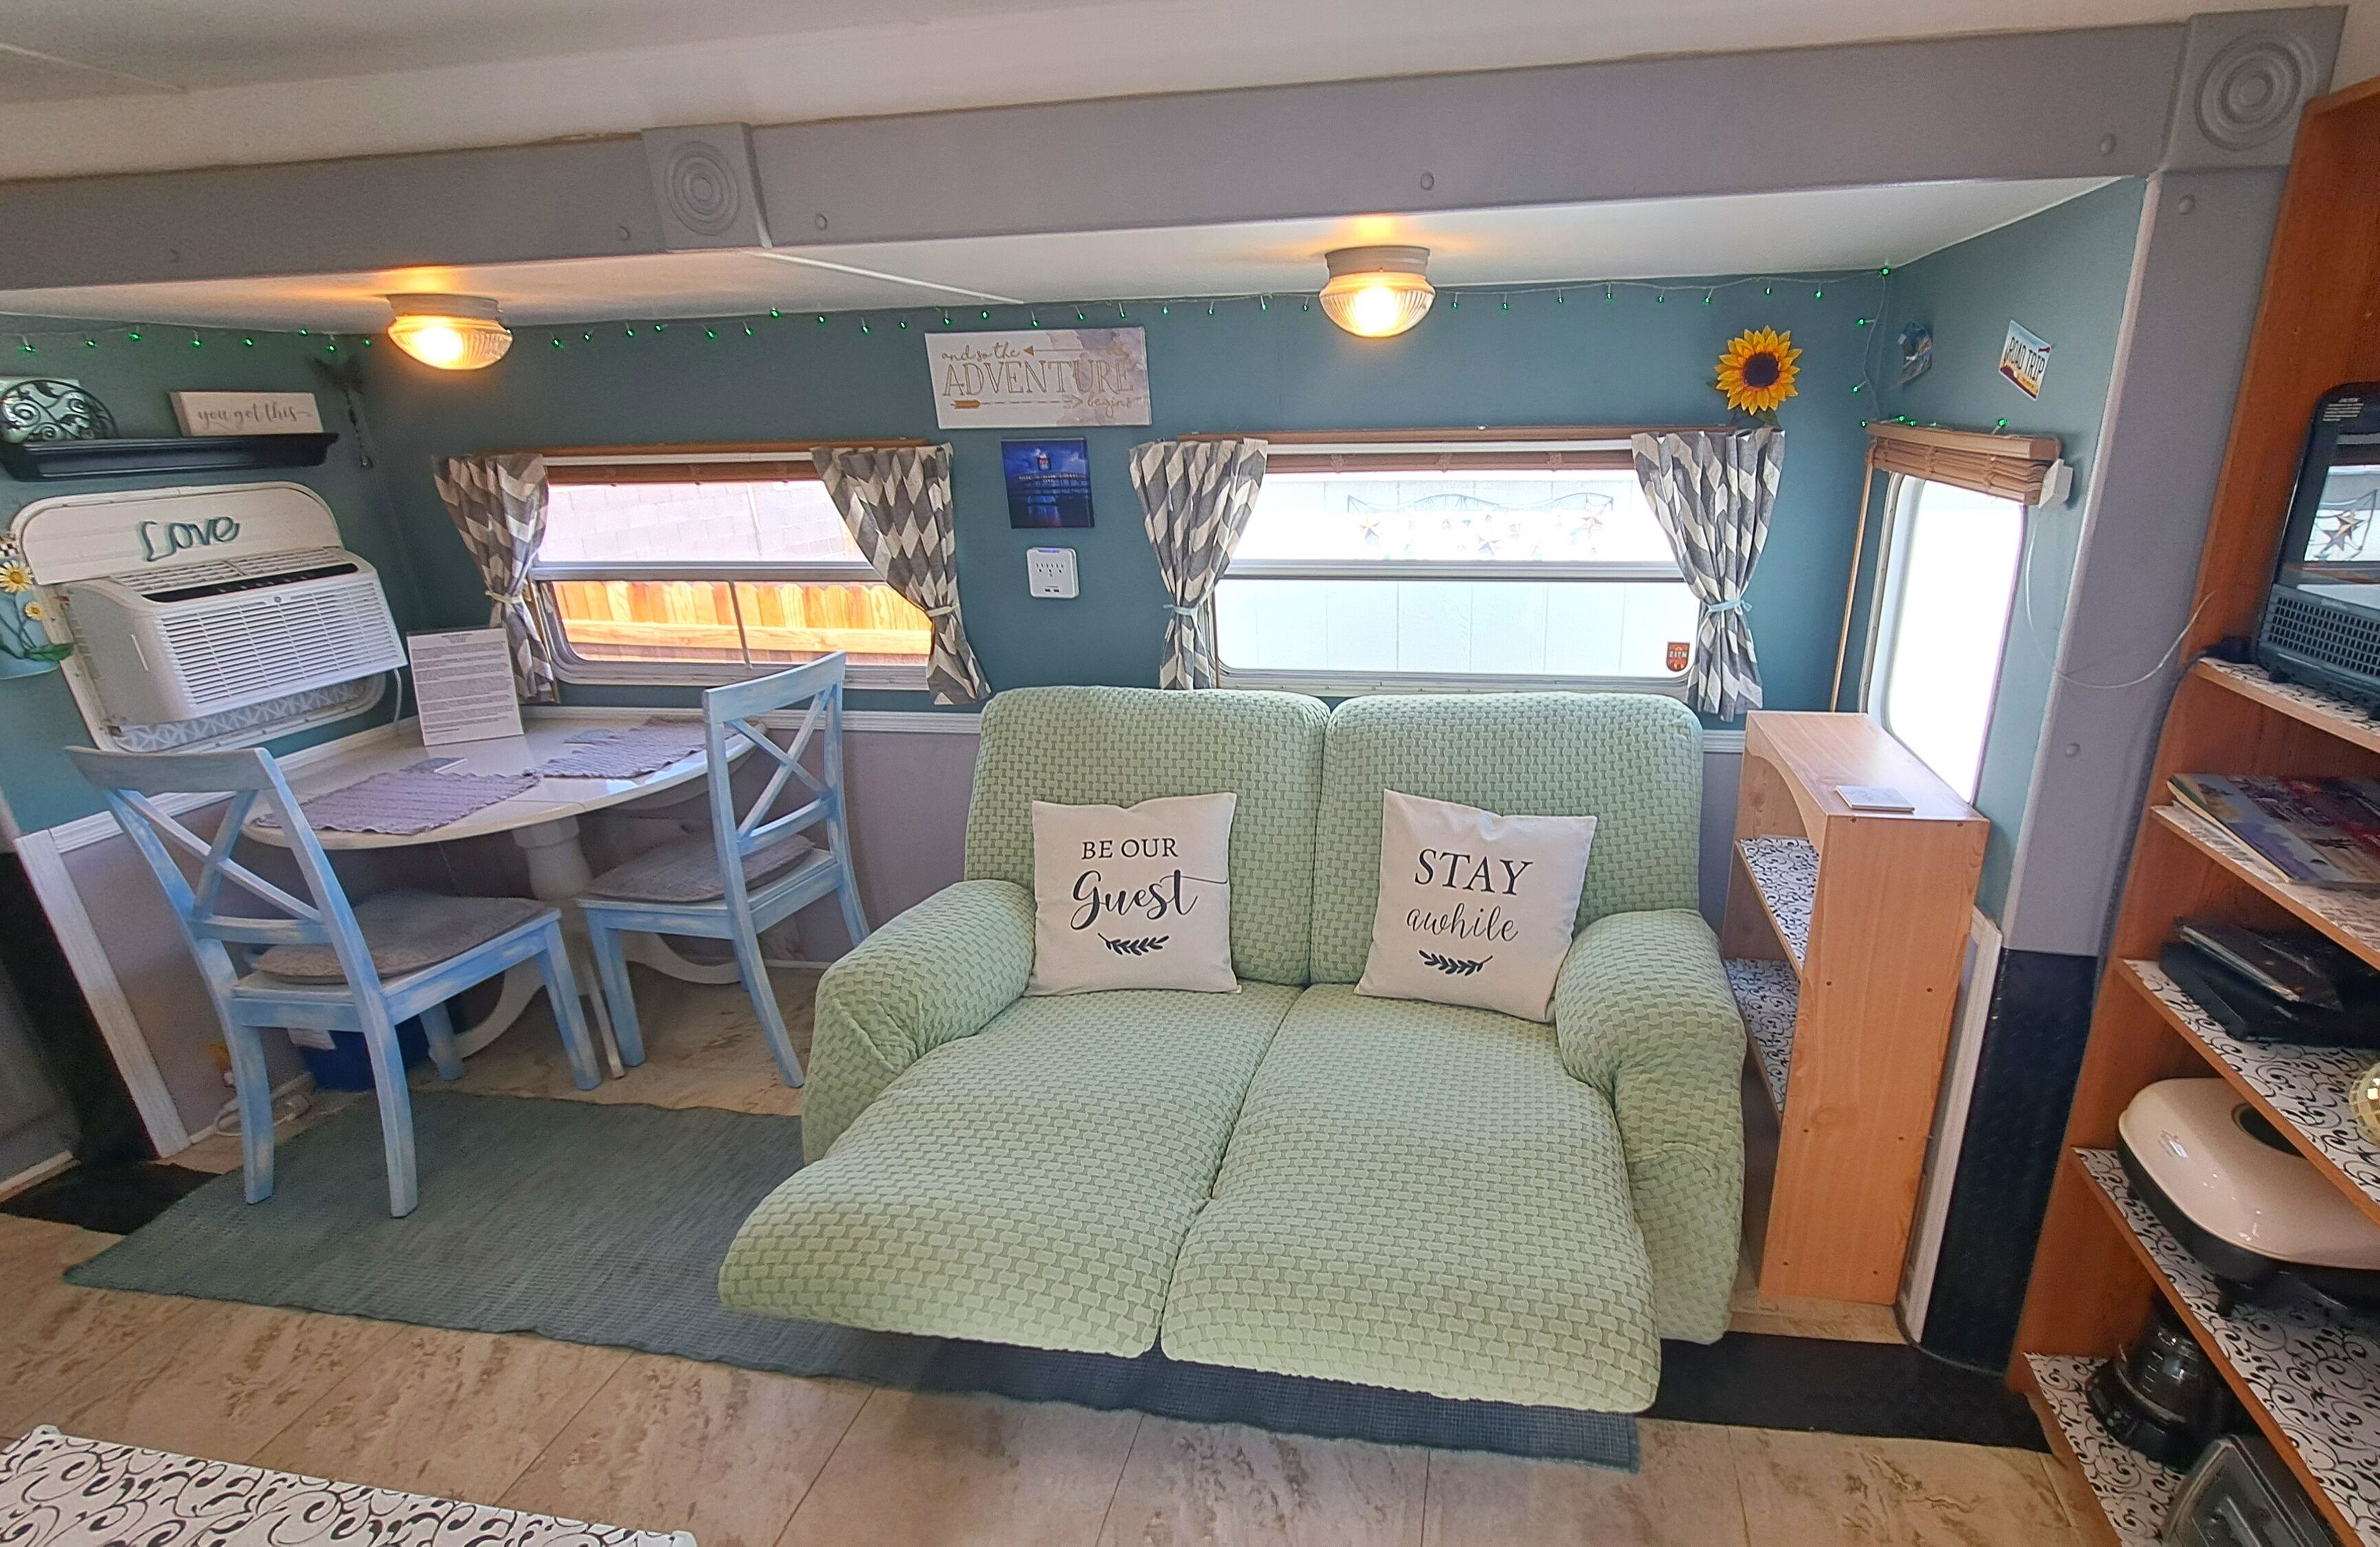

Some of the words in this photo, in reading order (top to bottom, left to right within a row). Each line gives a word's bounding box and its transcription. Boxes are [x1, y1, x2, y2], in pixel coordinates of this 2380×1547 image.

[992, 341, 1021, 360] the
[2024, 349, 2046, 382] TRIP
[941, 359, 1134, 397] ADVENTURE
[197, 409, 231, 431] you
[234, 403, 261, 430] got
[264, 401, 302, 423] this
[1087, 390, 1136, 418] begins
[140, 516, 240, 562] Love
[1081, 840, 1113, 860] BE
[1121, 837, 1179, 858] OUR
[1414, 848, 1534, 896] STAY
[1070, 868, 1228, 931] Guest
[1406, 902, 1519, 942] awhile
